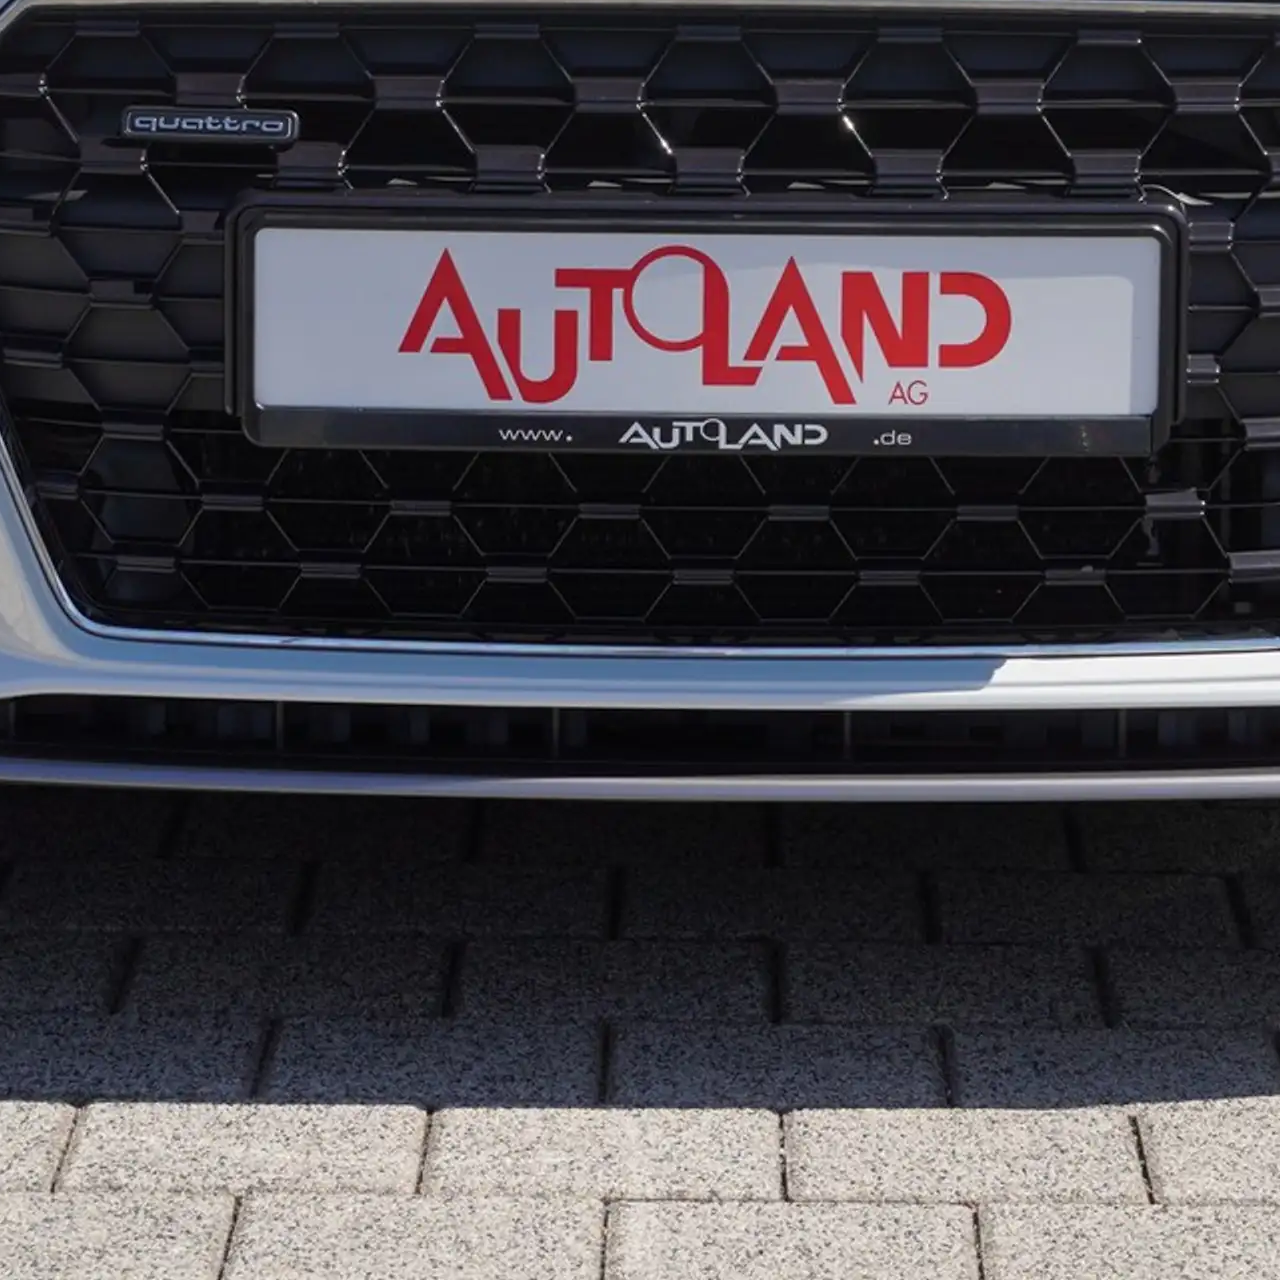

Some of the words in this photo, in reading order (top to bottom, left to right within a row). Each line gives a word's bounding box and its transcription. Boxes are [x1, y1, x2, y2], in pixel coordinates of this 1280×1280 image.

[134, 116, 284, 132] quattro
[397, 245, 1012, 405] AUTOLAND
[888, 380, 929, 406] AG
[498, 429, 572, 442] www.
[618, 418, 829, 451] AUTOLAND
[873, 429, 912, 446] .de
